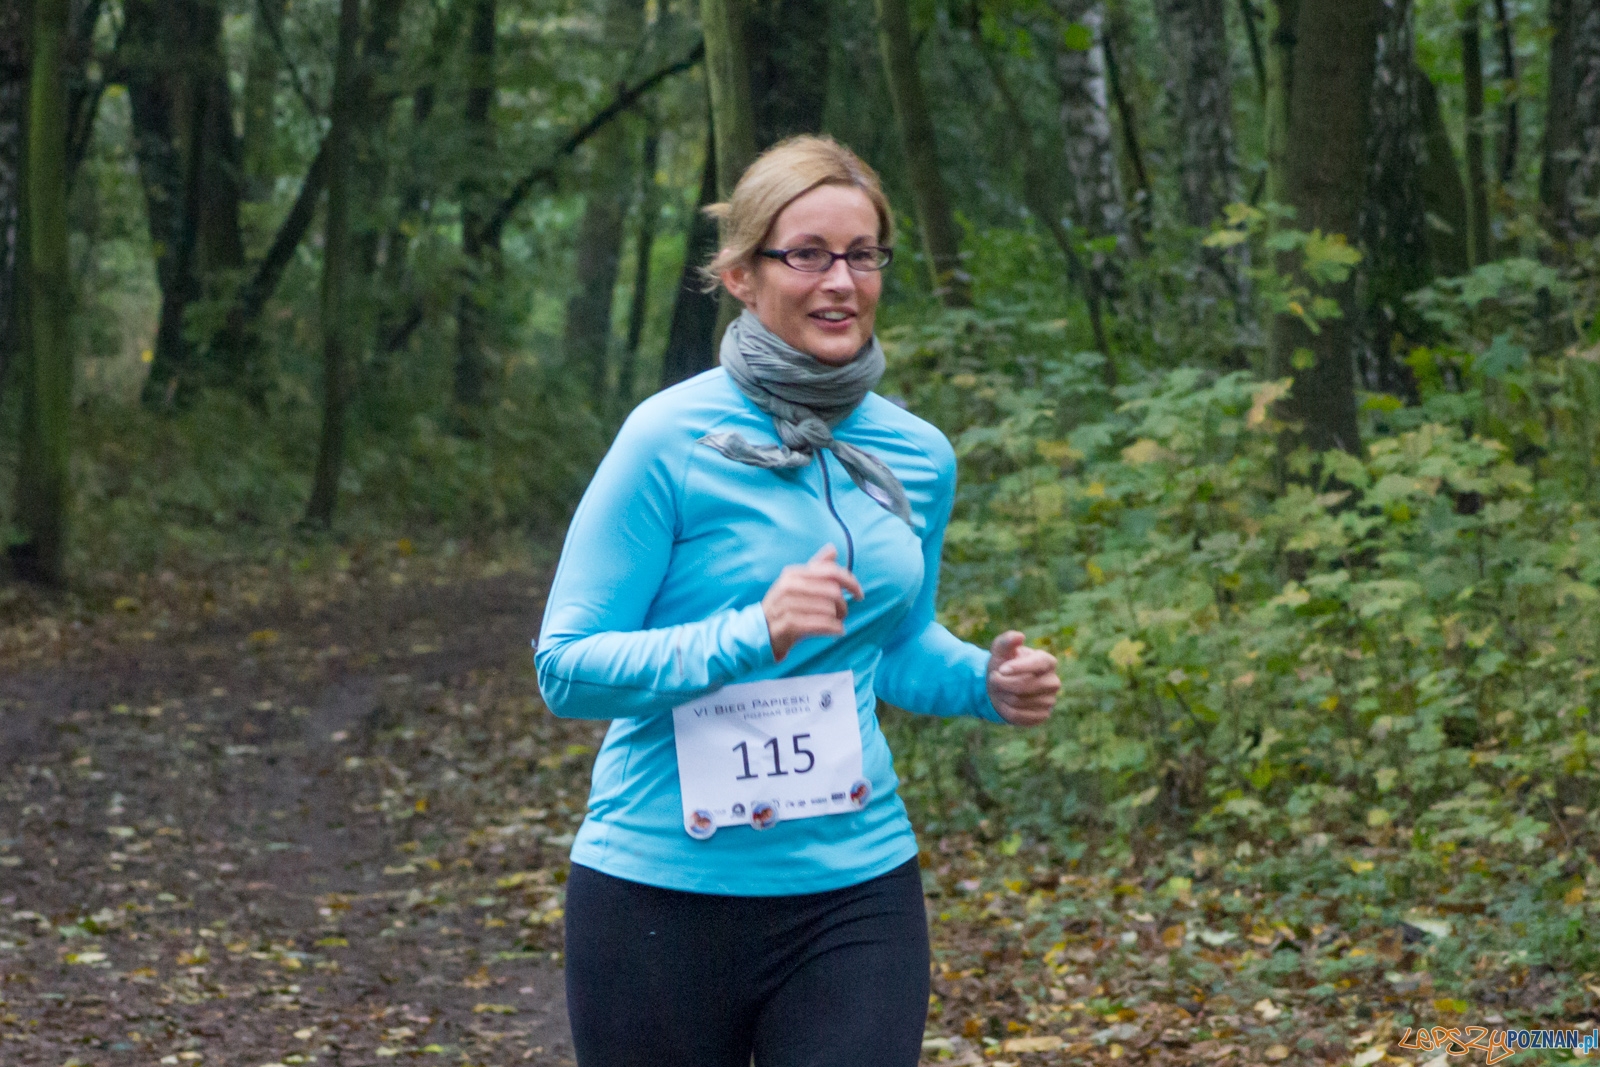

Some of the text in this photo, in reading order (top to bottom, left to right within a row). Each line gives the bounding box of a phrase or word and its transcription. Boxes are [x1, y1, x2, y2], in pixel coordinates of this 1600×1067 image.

[693, 695, 810, 719] VI BIEG PAPIESKI
[732, 733, 815, 781] 115
